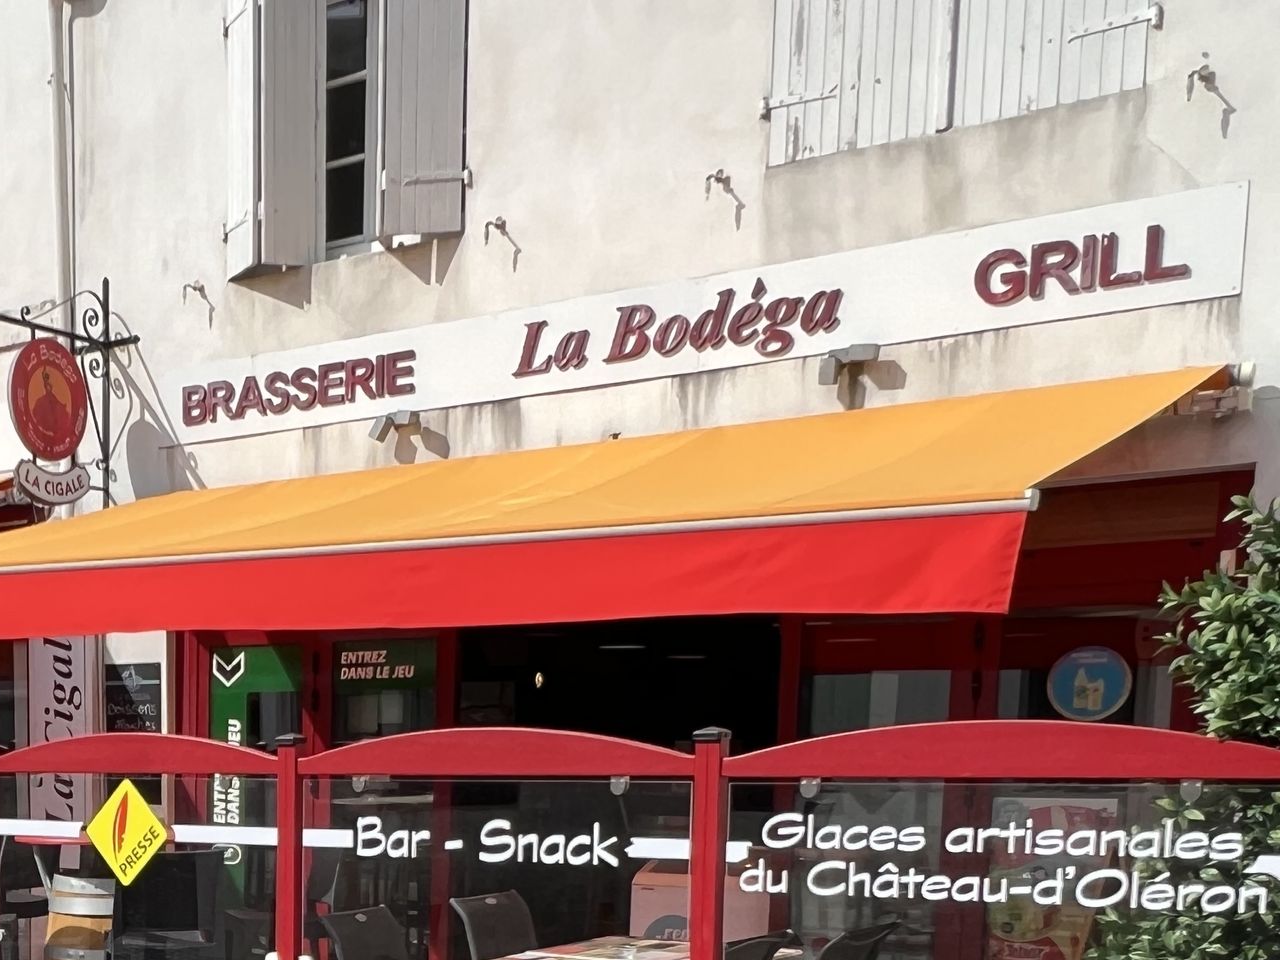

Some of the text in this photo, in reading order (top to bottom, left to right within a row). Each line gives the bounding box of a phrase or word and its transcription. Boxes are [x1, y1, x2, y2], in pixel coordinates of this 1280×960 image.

[182, 224, 1192, 427] BRASSERIE La Bodéga GRILL
[25, 468, 85, 497] LA CIGALE
[340, 650, 387, 665] ENTREZ
[340, 665, 415, 680] DANS LE JEU
[119, 826, 159, 877] PRESSE
[356, 816, 431, 858] Bar
[479, 819, 619, 867] Snack
[761, 813, 1244, 860] Glaces artisanales
[739, 858, 1269, 914] du Château-d'Oléron
